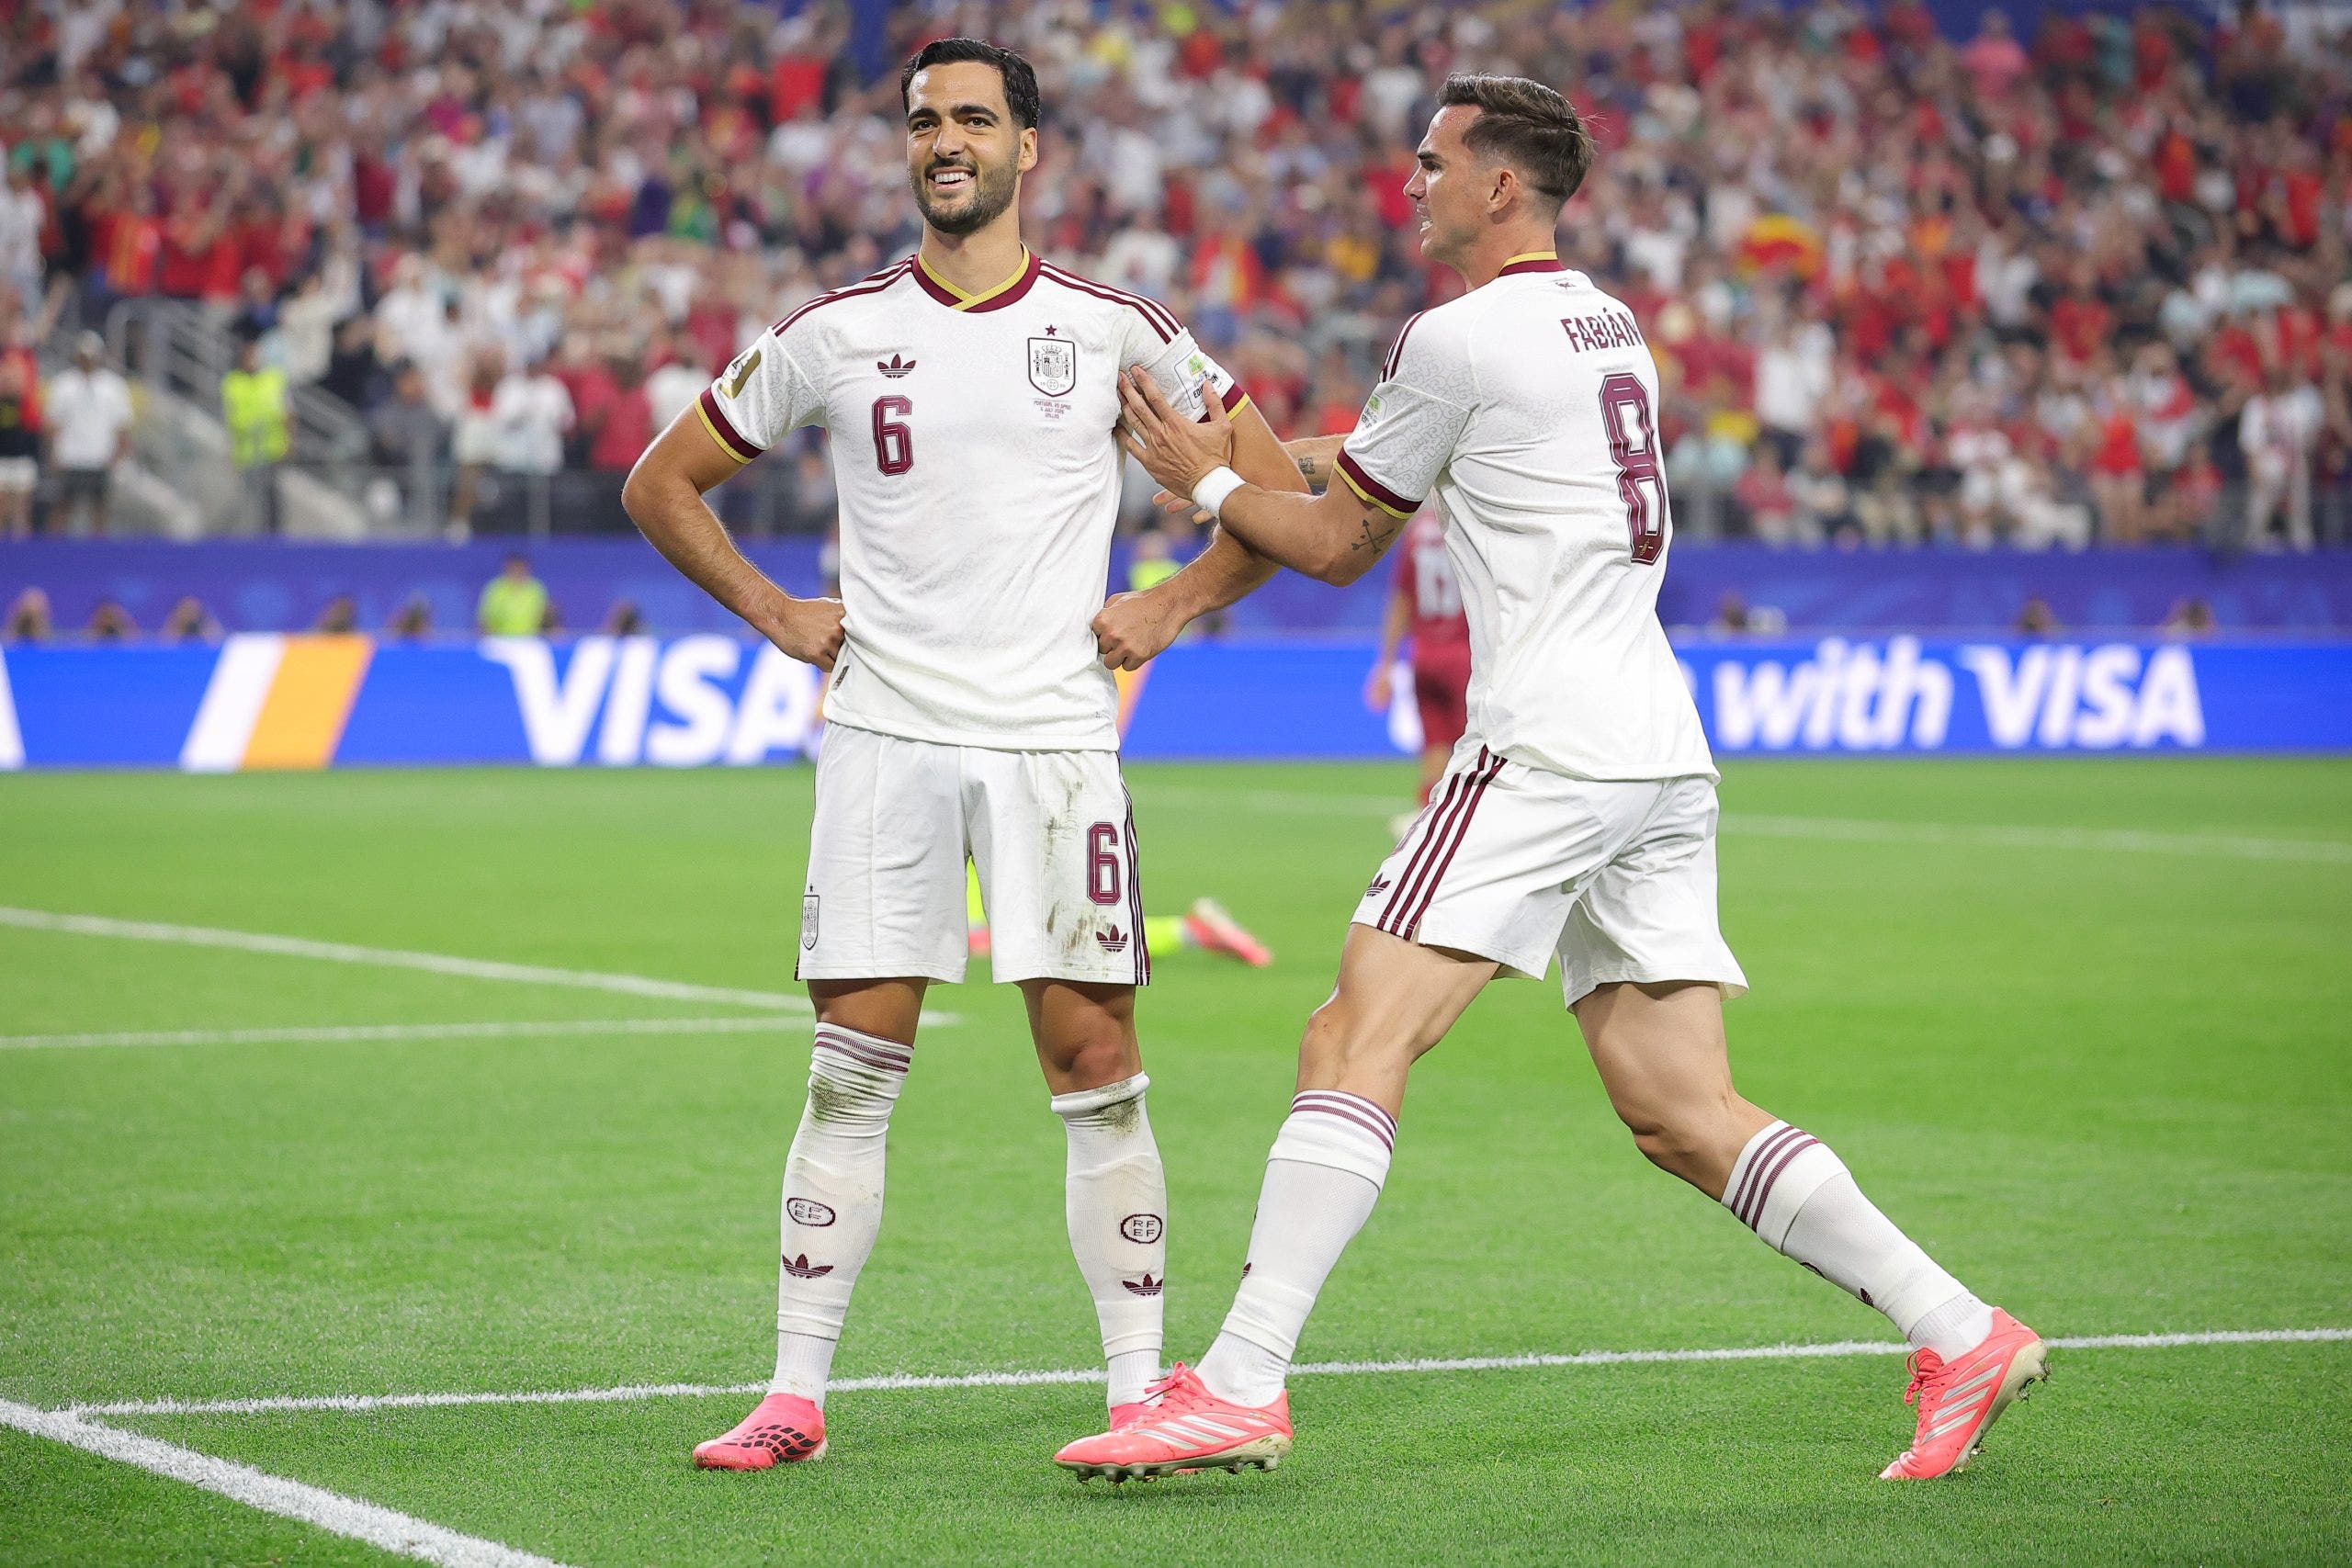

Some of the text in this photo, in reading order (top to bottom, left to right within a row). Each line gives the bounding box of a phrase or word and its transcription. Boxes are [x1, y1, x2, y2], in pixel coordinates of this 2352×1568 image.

[1560, 307, 1642, 353] FABIÁN
[872, 395, 913, 477] 6
[1599, 372, 1665, 566] 8
[480, 634, 820, 766] VISA
[1713, 635, 1955, 749] with
[1960, 642, 2204, 749] VISA
[1086, 821, 1122, 906] 6
